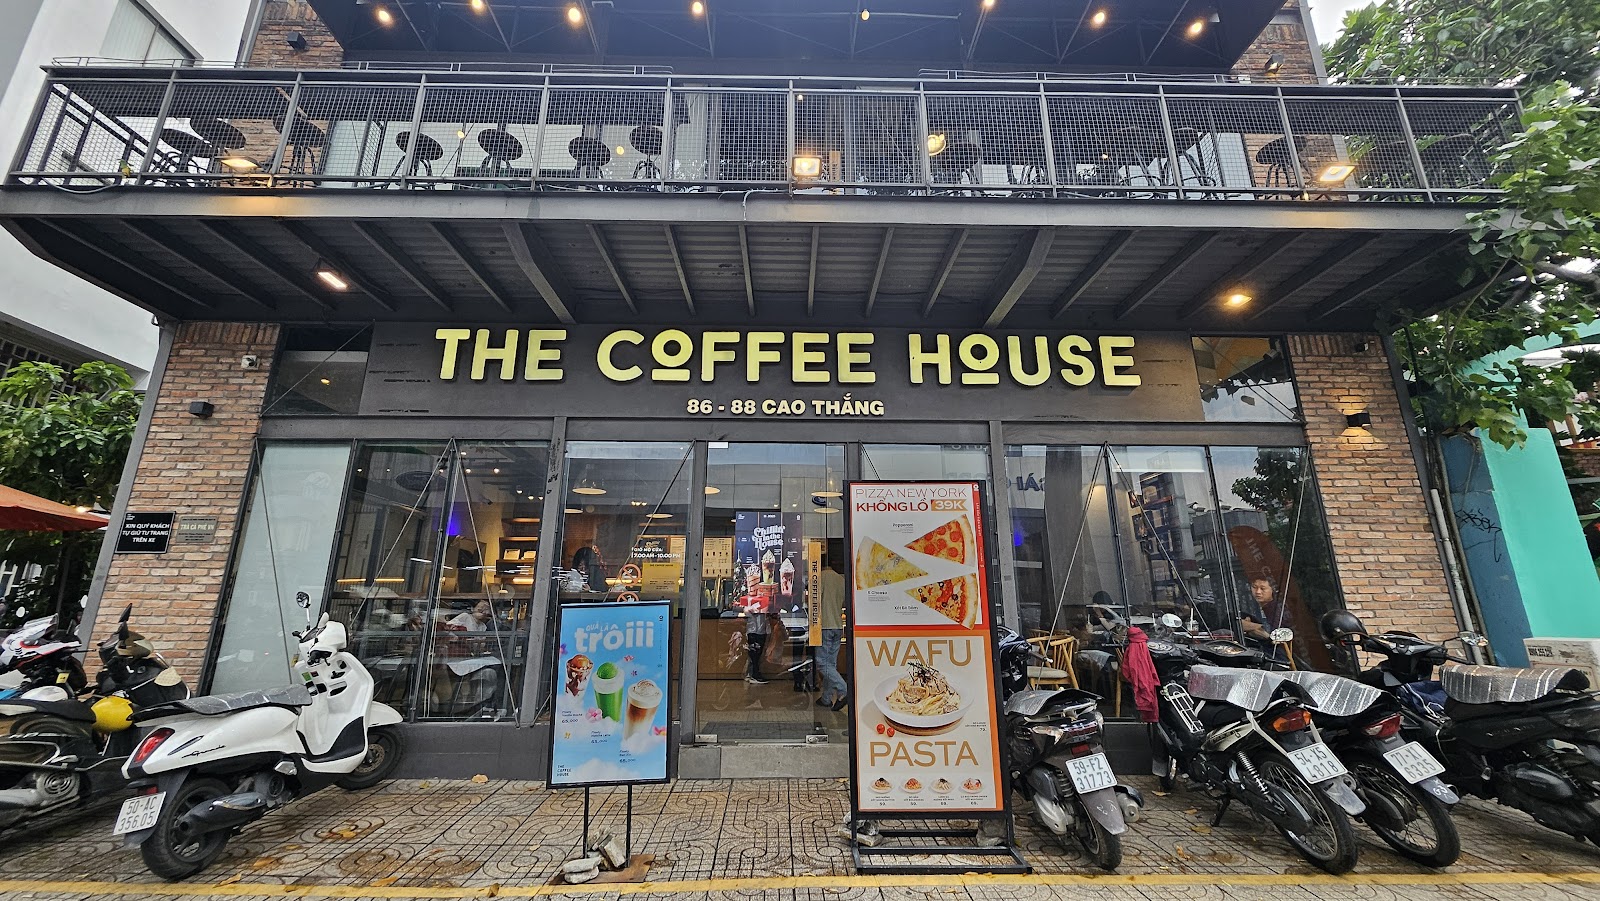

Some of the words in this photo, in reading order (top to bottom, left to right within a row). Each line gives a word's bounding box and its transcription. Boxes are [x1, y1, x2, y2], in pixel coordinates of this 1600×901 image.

[435, 328, 567, 381] THE
[597, 329, 877, 383] COFFEE
[908, 333, 1142, 386] HOUSE
[686, 399, 713, 414] 86
[730, 399, 757, 415] 88
[761, 399, 806, 416] CAO
[811, 392, 885, 416] THẮNG
[855, 487, 895, 499] PIZZA
[897, 487, 930, 498] NEW
[929, 487, 968, 498] YORK
[934, 500, 965, 510] 39K
[866, 639, 972, 667] WAFU
[869, 740, 979, 767] PASTA
[1072, 757, 1104, 775] 59-F2
[1306, 760, 1339, 779] 4818
[1403, 758, 1437, 779] 6335
[1076, 770, 1113, 790] 317.73
[126, 796, 158, 815] 50-AC
[117, 811, 156, 832] 356.05
